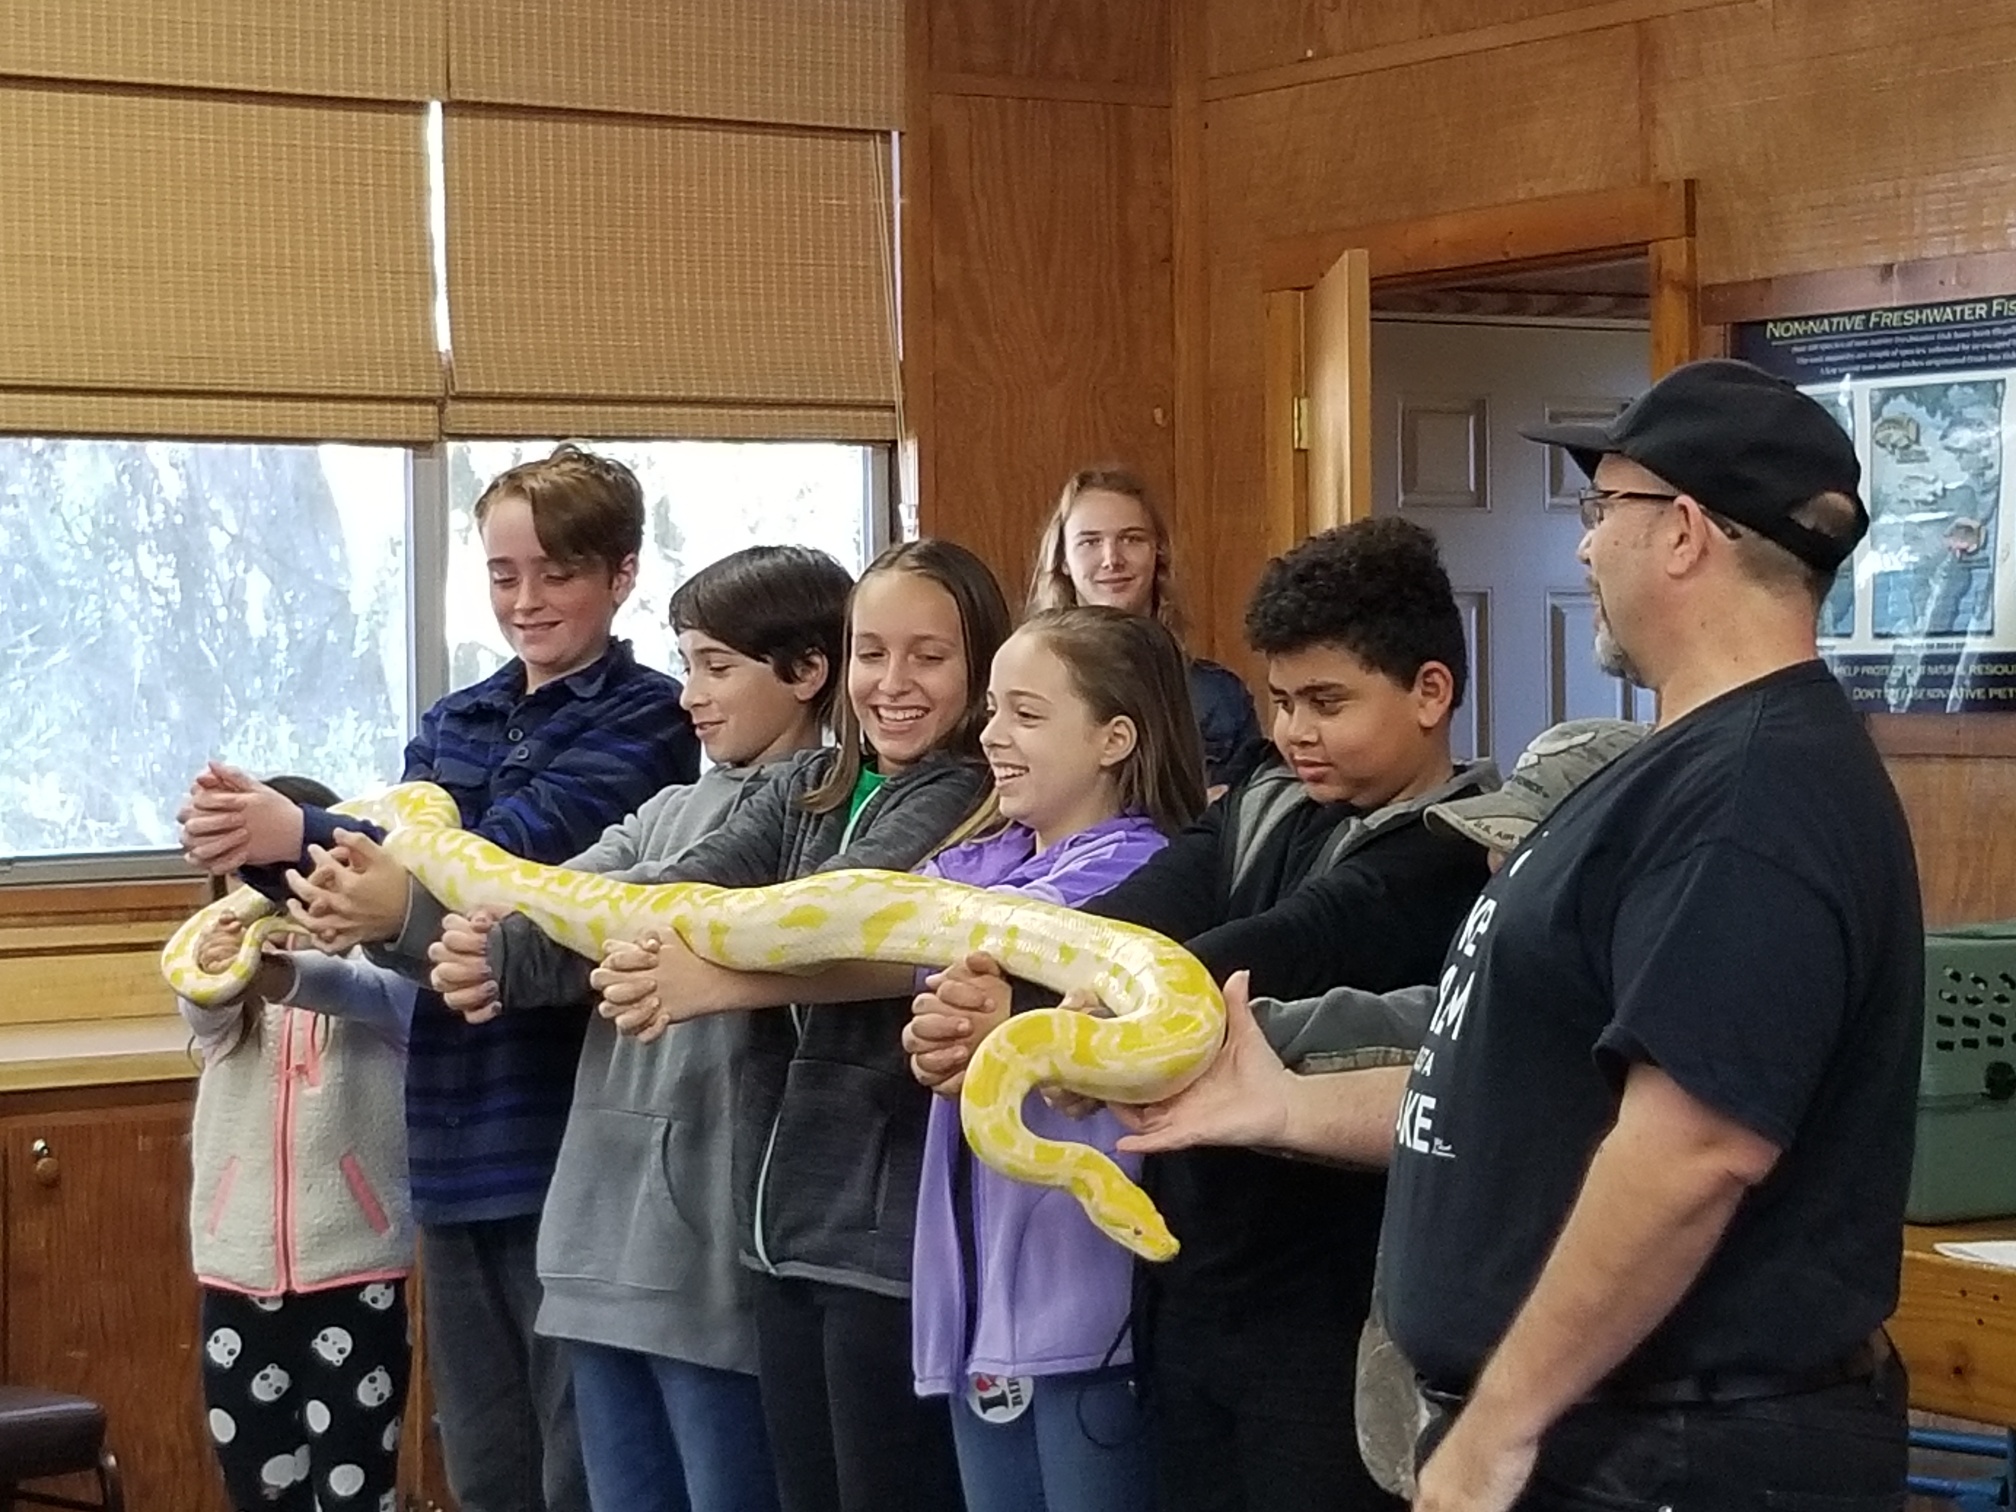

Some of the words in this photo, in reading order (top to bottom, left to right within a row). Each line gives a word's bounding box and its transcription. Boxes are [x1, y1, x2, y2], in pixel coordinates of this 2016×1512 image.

[1766, 314, 1867, 339] NON-NATIVE
[1869, 302, 1988, 329] FRESHWATER
[1396, 1089, 1437, 1154] KE
